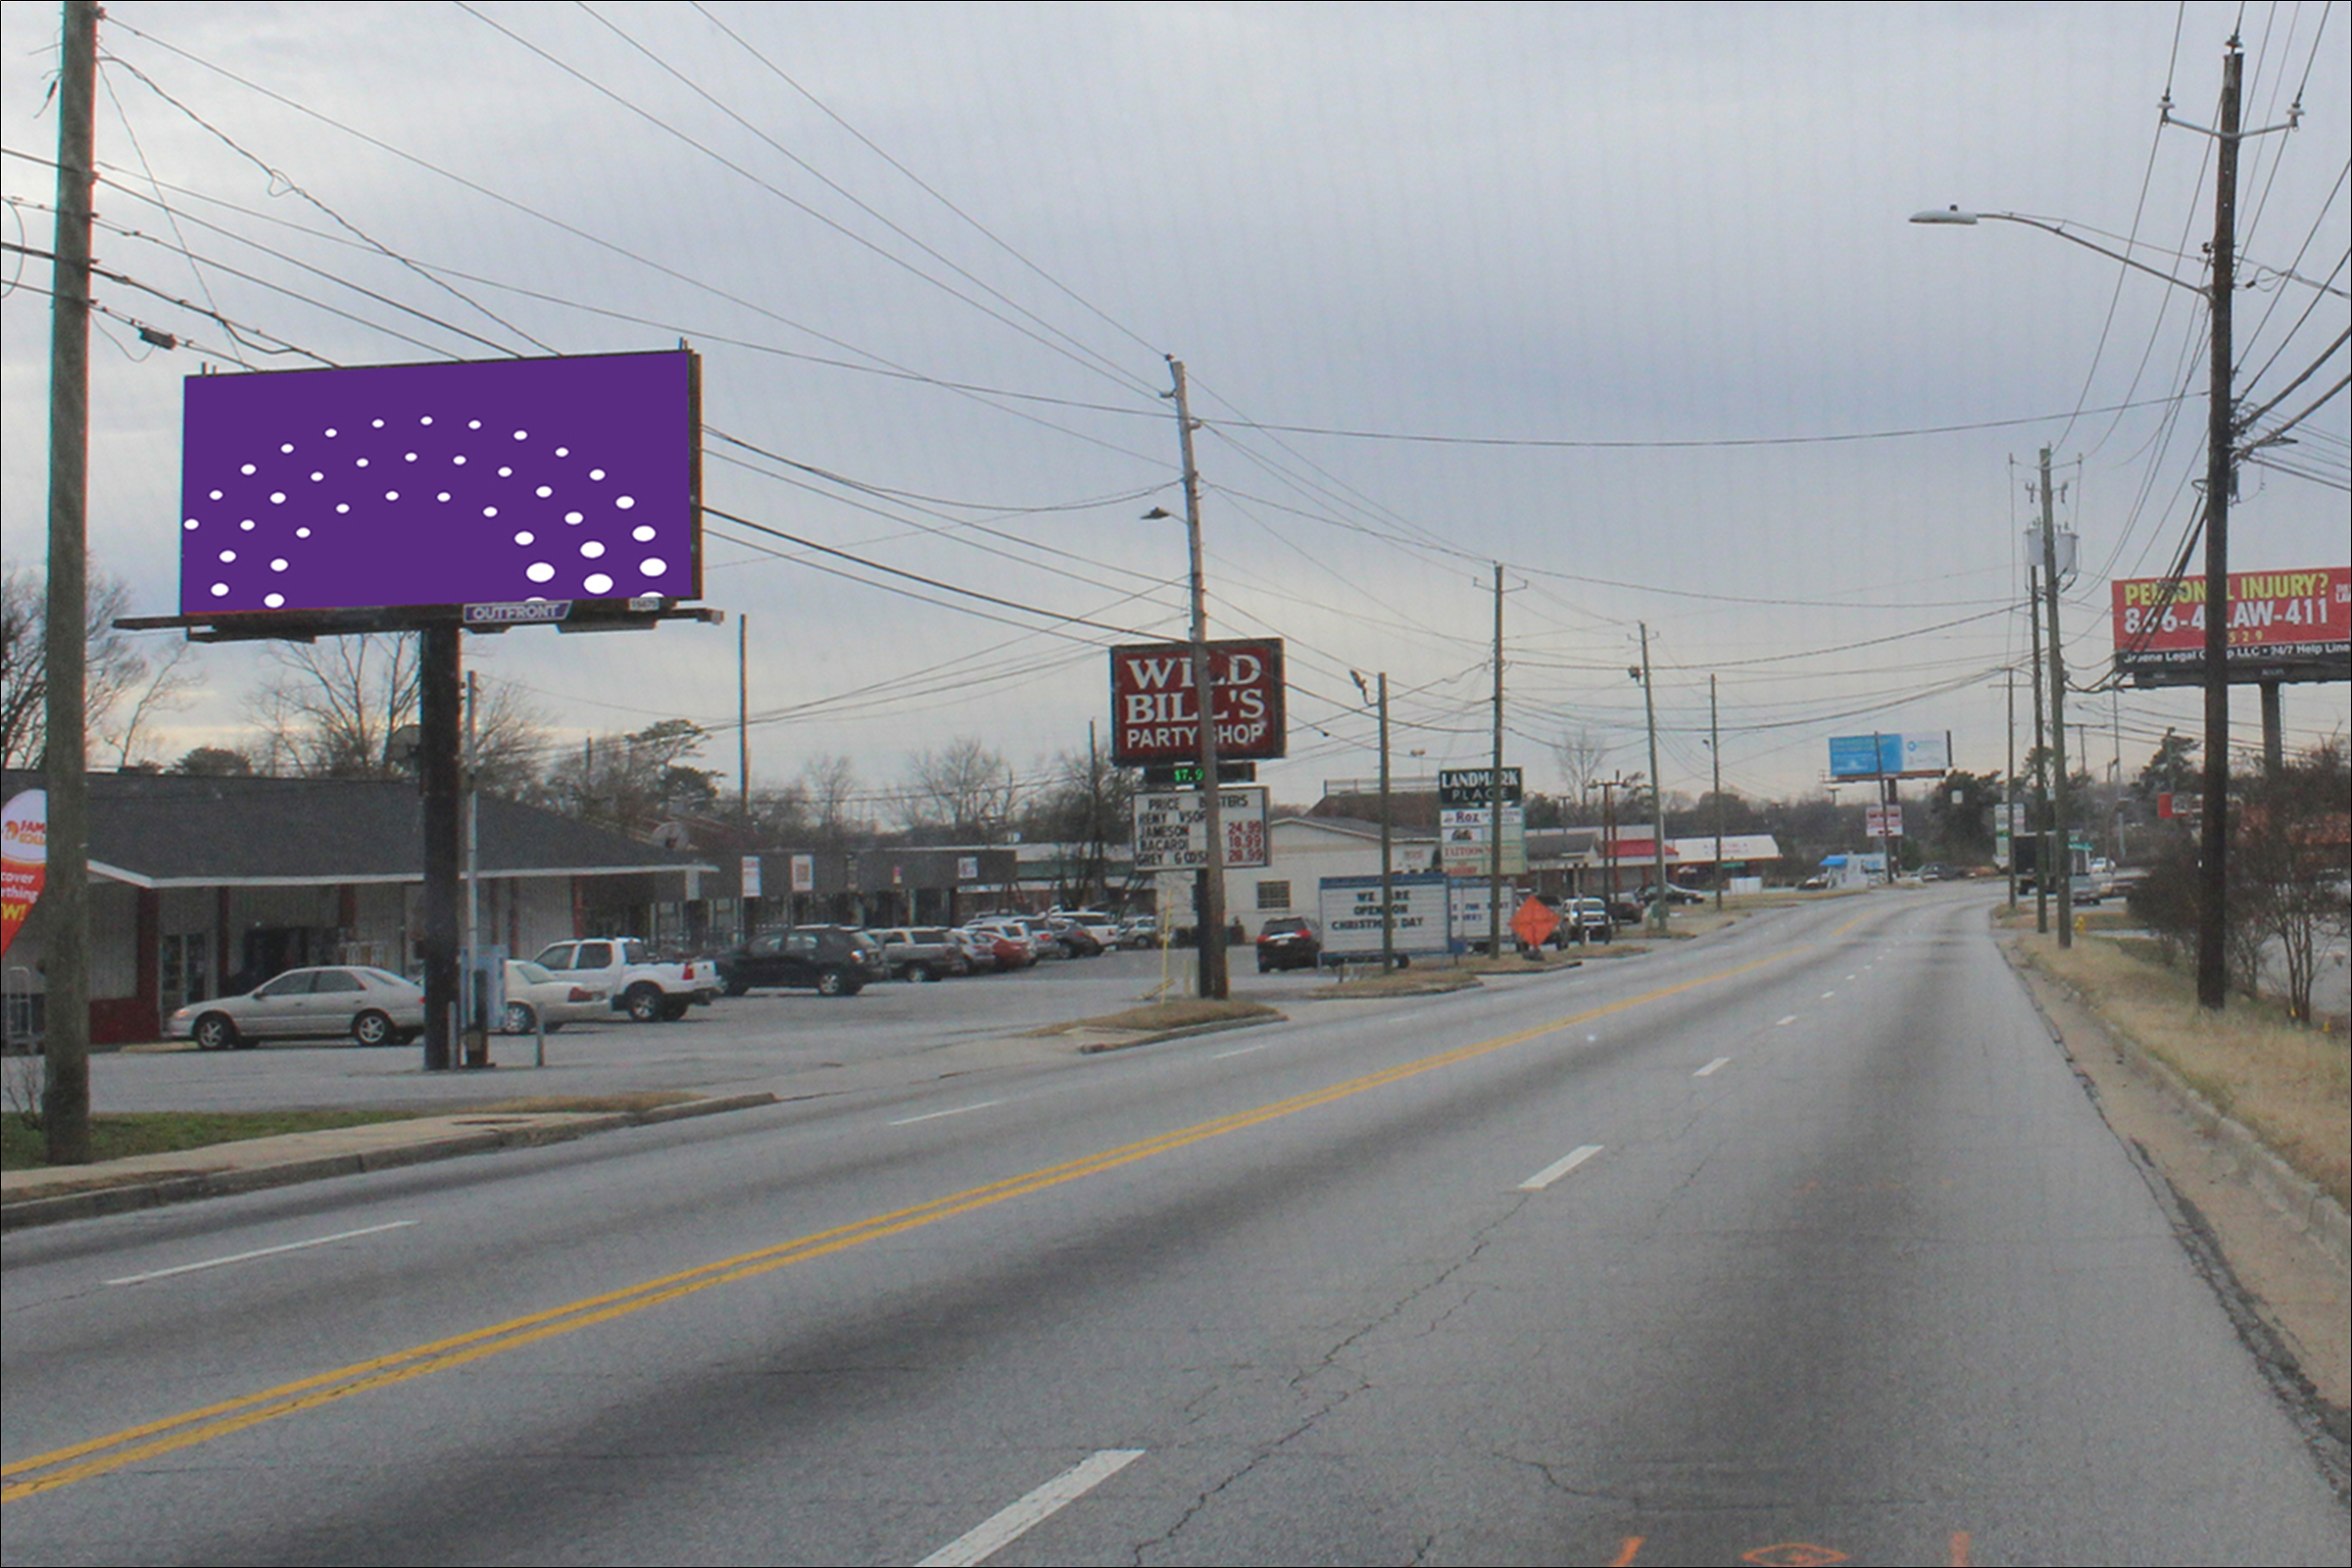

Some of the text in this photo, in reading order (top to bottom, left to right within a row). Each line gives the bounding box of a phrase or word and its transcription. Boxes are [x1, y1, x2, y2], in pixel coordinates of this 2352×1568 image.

[2125, 572, 2328, 606] PEONL INJURY?
[473, 604, 559, 620] OUTFRONT
[2165, 651, 2197, 662] Legal
[2237, 646, 2259, 657] LLC
[2270, 645, 2292, 655] 24/7
[2296, 643, 2322, 655] Help
[2326, 642, 2350, 653] Line
[1126, 655, 1262, 690] WID
[1127, 726, 1199, 749] PARTY
[1452, 788, 1508, 801] PLACE
[1148, 795, 1249, 810] PRICE BTERS
[20, 819, 46, 833] FAM
[1174, 851, 1208, 865] GOOS
[1356, 890, 1410, 902] WE RE
[1353, 905, 1384, 916] OPEN
[1331, 916, 1424, 930] CHRISTMS DAY
